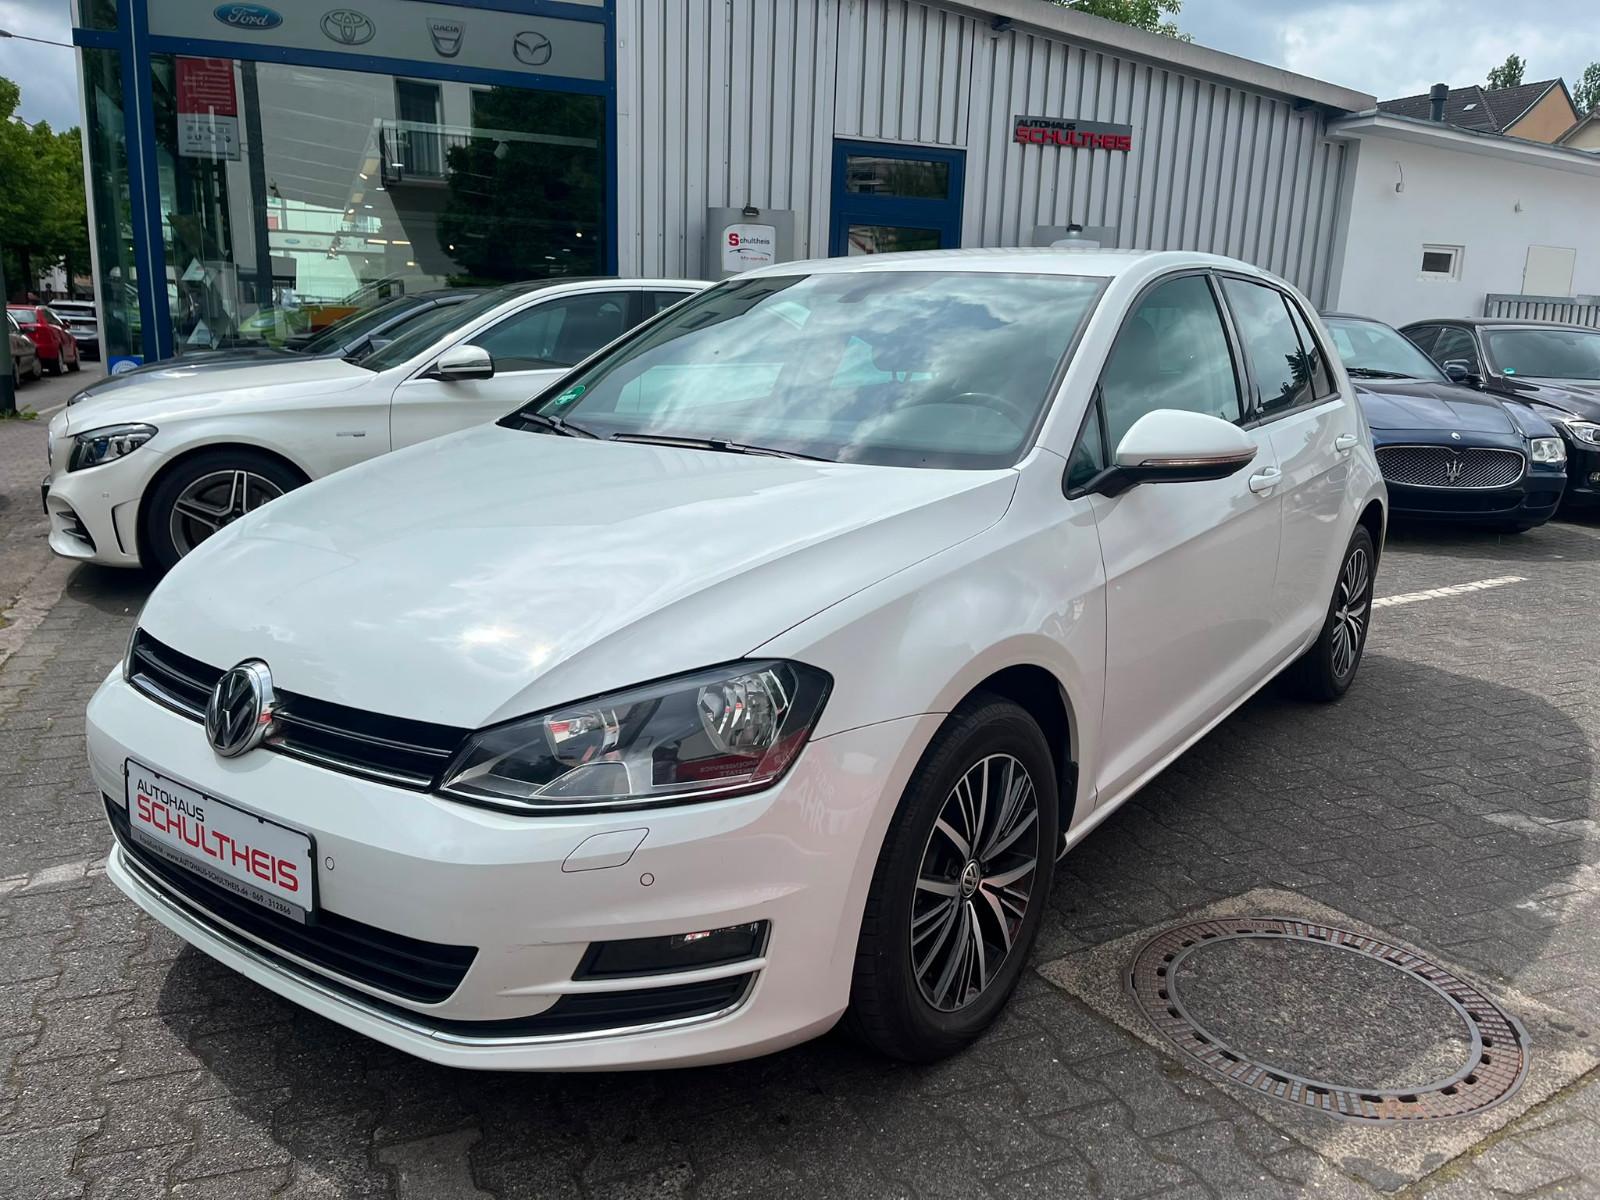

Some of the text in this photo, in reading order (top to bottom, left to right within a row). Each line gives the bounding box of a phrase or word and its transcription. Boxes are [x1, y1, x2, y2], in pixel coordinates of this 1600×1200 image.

[227, 6, 268, 26] Ford
[1017, 119, 1077, 130] AUTOHAUS
[1015, 127, 1132, 151] SCHULTHEIS
[728, 232, 770, 247] Schultheis
[137, 779, 205, 823] AUTOHAUS
[137, 793, 299, 892] SCHULTHEIS
[252, 892, 264, 903] 069
